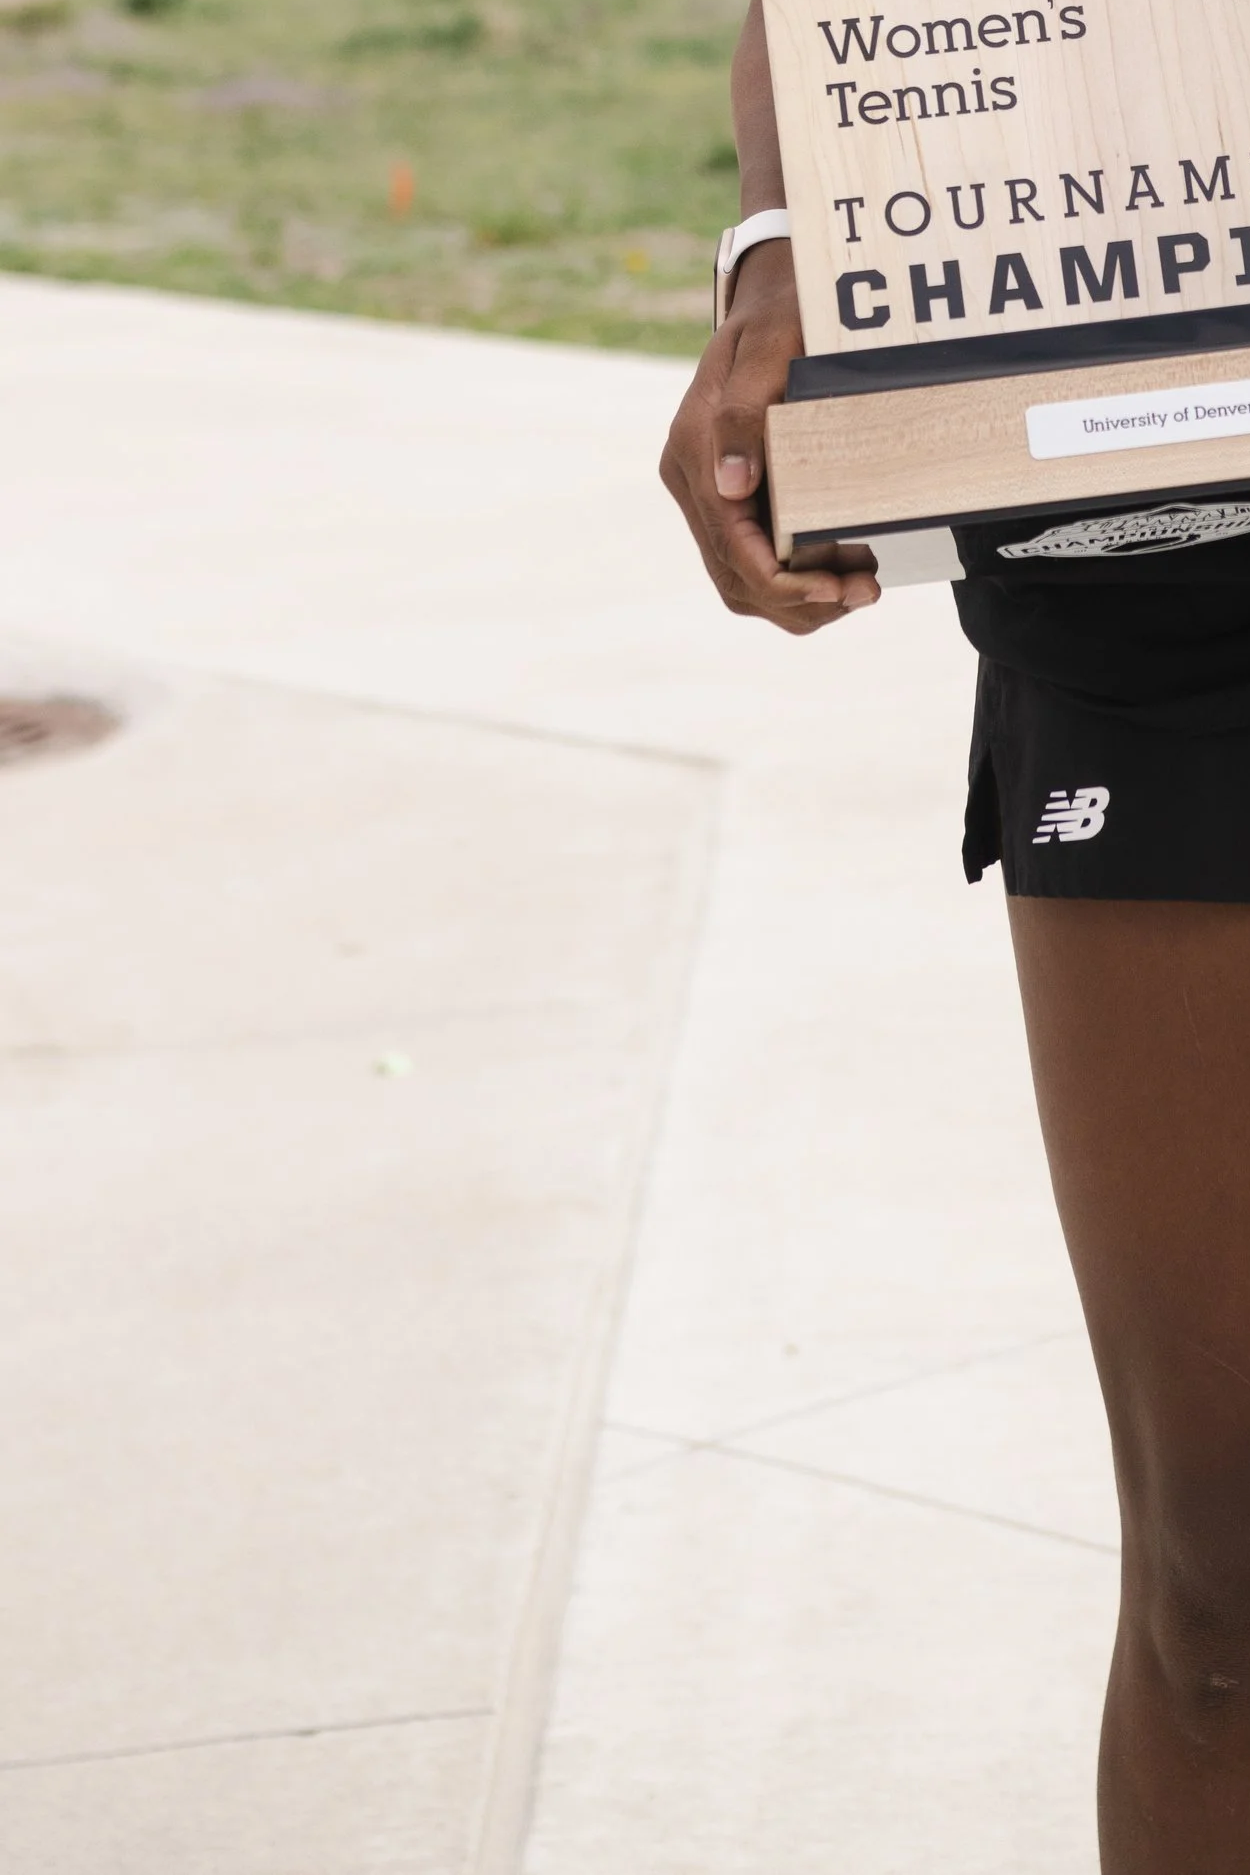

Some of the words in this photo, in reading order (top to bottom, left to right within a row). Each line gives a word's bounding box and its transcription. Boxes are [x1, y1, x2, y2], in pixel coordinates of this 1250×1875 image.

[826, 67, 1019, 129] Tennis
[1082, 410, 1168, 434] University
[1173, 407, 1191, 423] of
